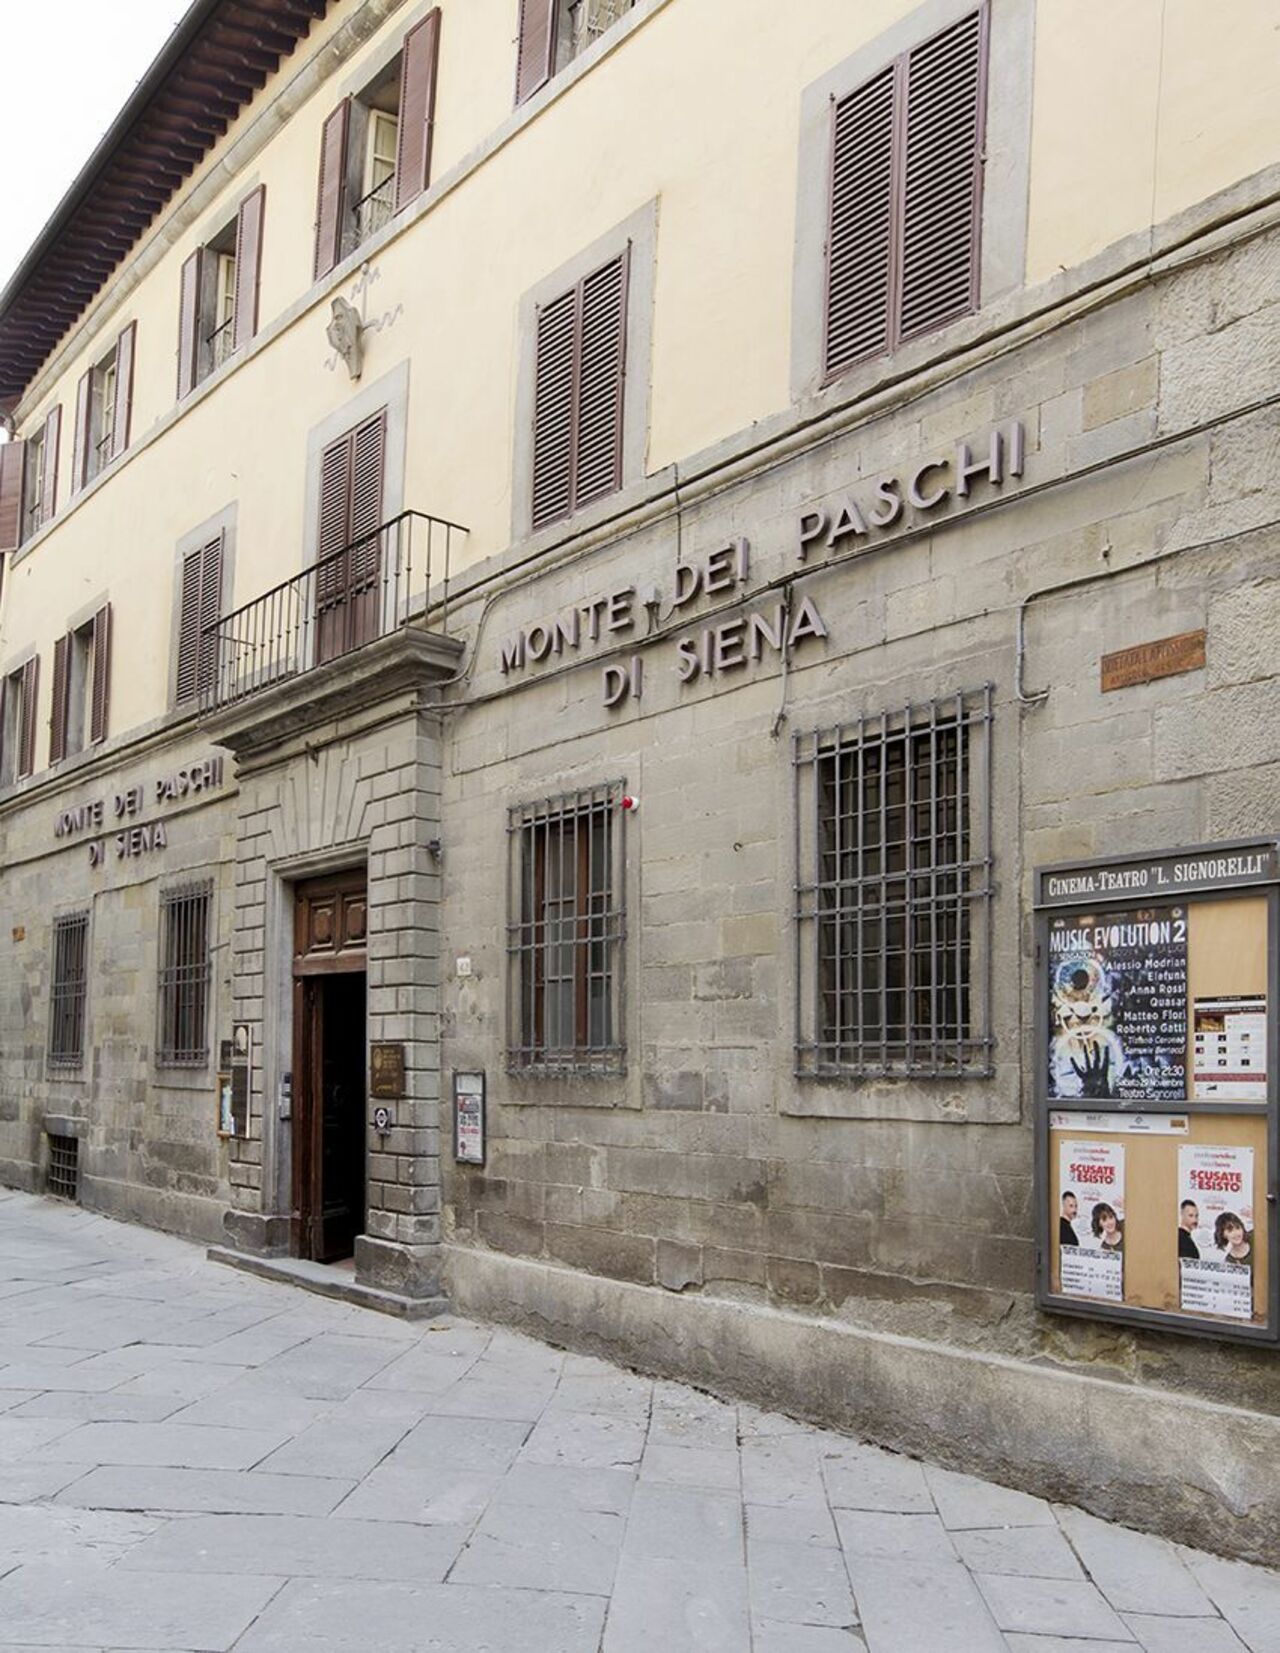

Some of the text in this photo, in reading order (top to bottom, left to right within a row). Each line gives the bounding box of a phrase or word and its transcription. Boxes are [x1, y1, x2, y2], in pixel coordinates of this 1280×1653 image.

[501, 421, 1025, 673] MONTE DEI PASCHI
[602, 595, 828, 708] DI SIENA
[54, 756, 223, 837] MONTE DEI PASCHI
[89, 822, 167, 868] DI SIENA
[1174, 853, 1270, 882] SIGNORELLI"
[1050, 928, 1092, 952] MUSIC
[1094, 920, 1170, 949] EVOLUTION
[1173, 919, 1186, 943] 2
[1106, 960, 1142, 971] Alessio
[1148, 970, 1186, 981] Elefunk
[1130, 982, 1186, 995] Anna Rossi
[1150, 997, 1186, 1007] Quasar
[1124, 1010, 1159, 1021] Matteo
[1116, 1022, 1186, 1033] Roberto Gatti
[1119, 1087, 1145, 1098] Teatro
[1070, 1163, 1115, 1176] SCUSATE
[1190, 1169, 1242, 1182] SCUSATE
[1077, 1173, 1114, 1185] ESISTO
[1198, 1181, 1241, 1193] ESISTO
